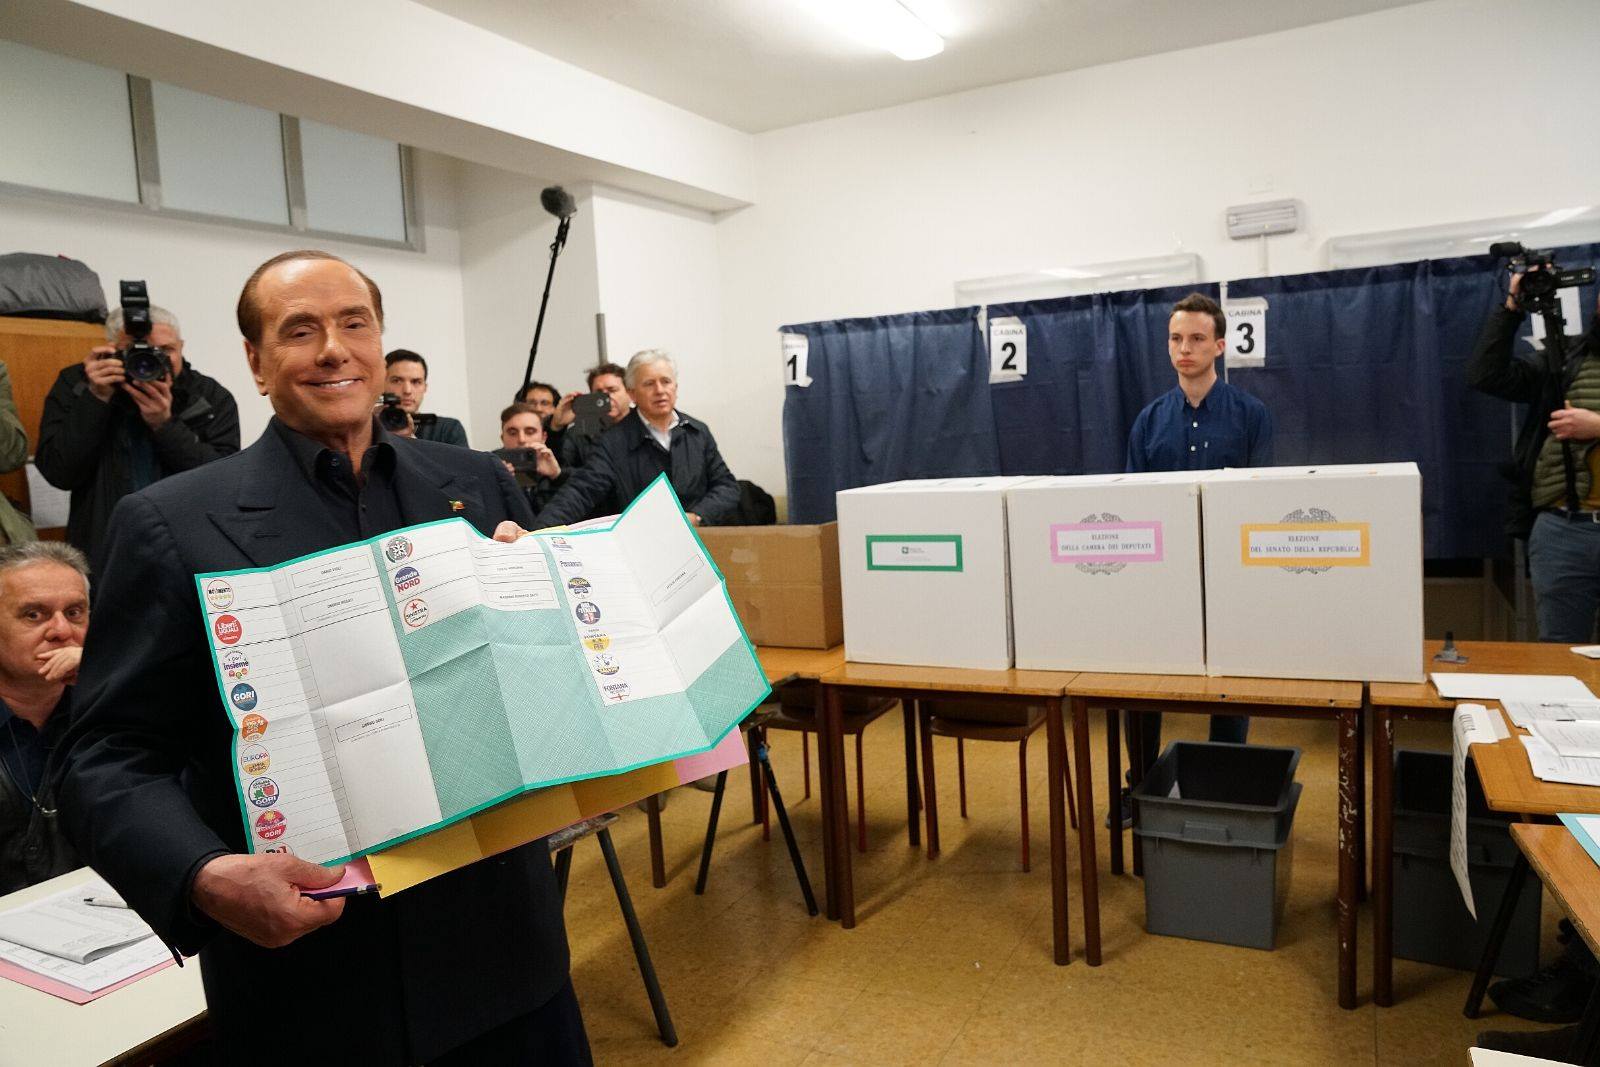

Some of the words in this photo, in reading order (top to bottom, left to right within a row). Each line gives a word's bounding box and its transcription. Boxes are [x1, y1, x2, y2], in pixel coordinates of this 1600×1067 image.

[1236, 322, 1254, 354] 3
[1001, 342, 1017, 370] 2
[787, 354, 798, 381] 1
[1091, 533, 1119, 541] ELEZIONE
[395, 571, 418, 584] Grande
[397, 577, 421, 593] NORD
[223, 660, 249, 671] insieme
[233, 690, 255, 702] GORI
[243, 752, 268, 763] EUROPA
[256, 795, 277, 806] GORI
